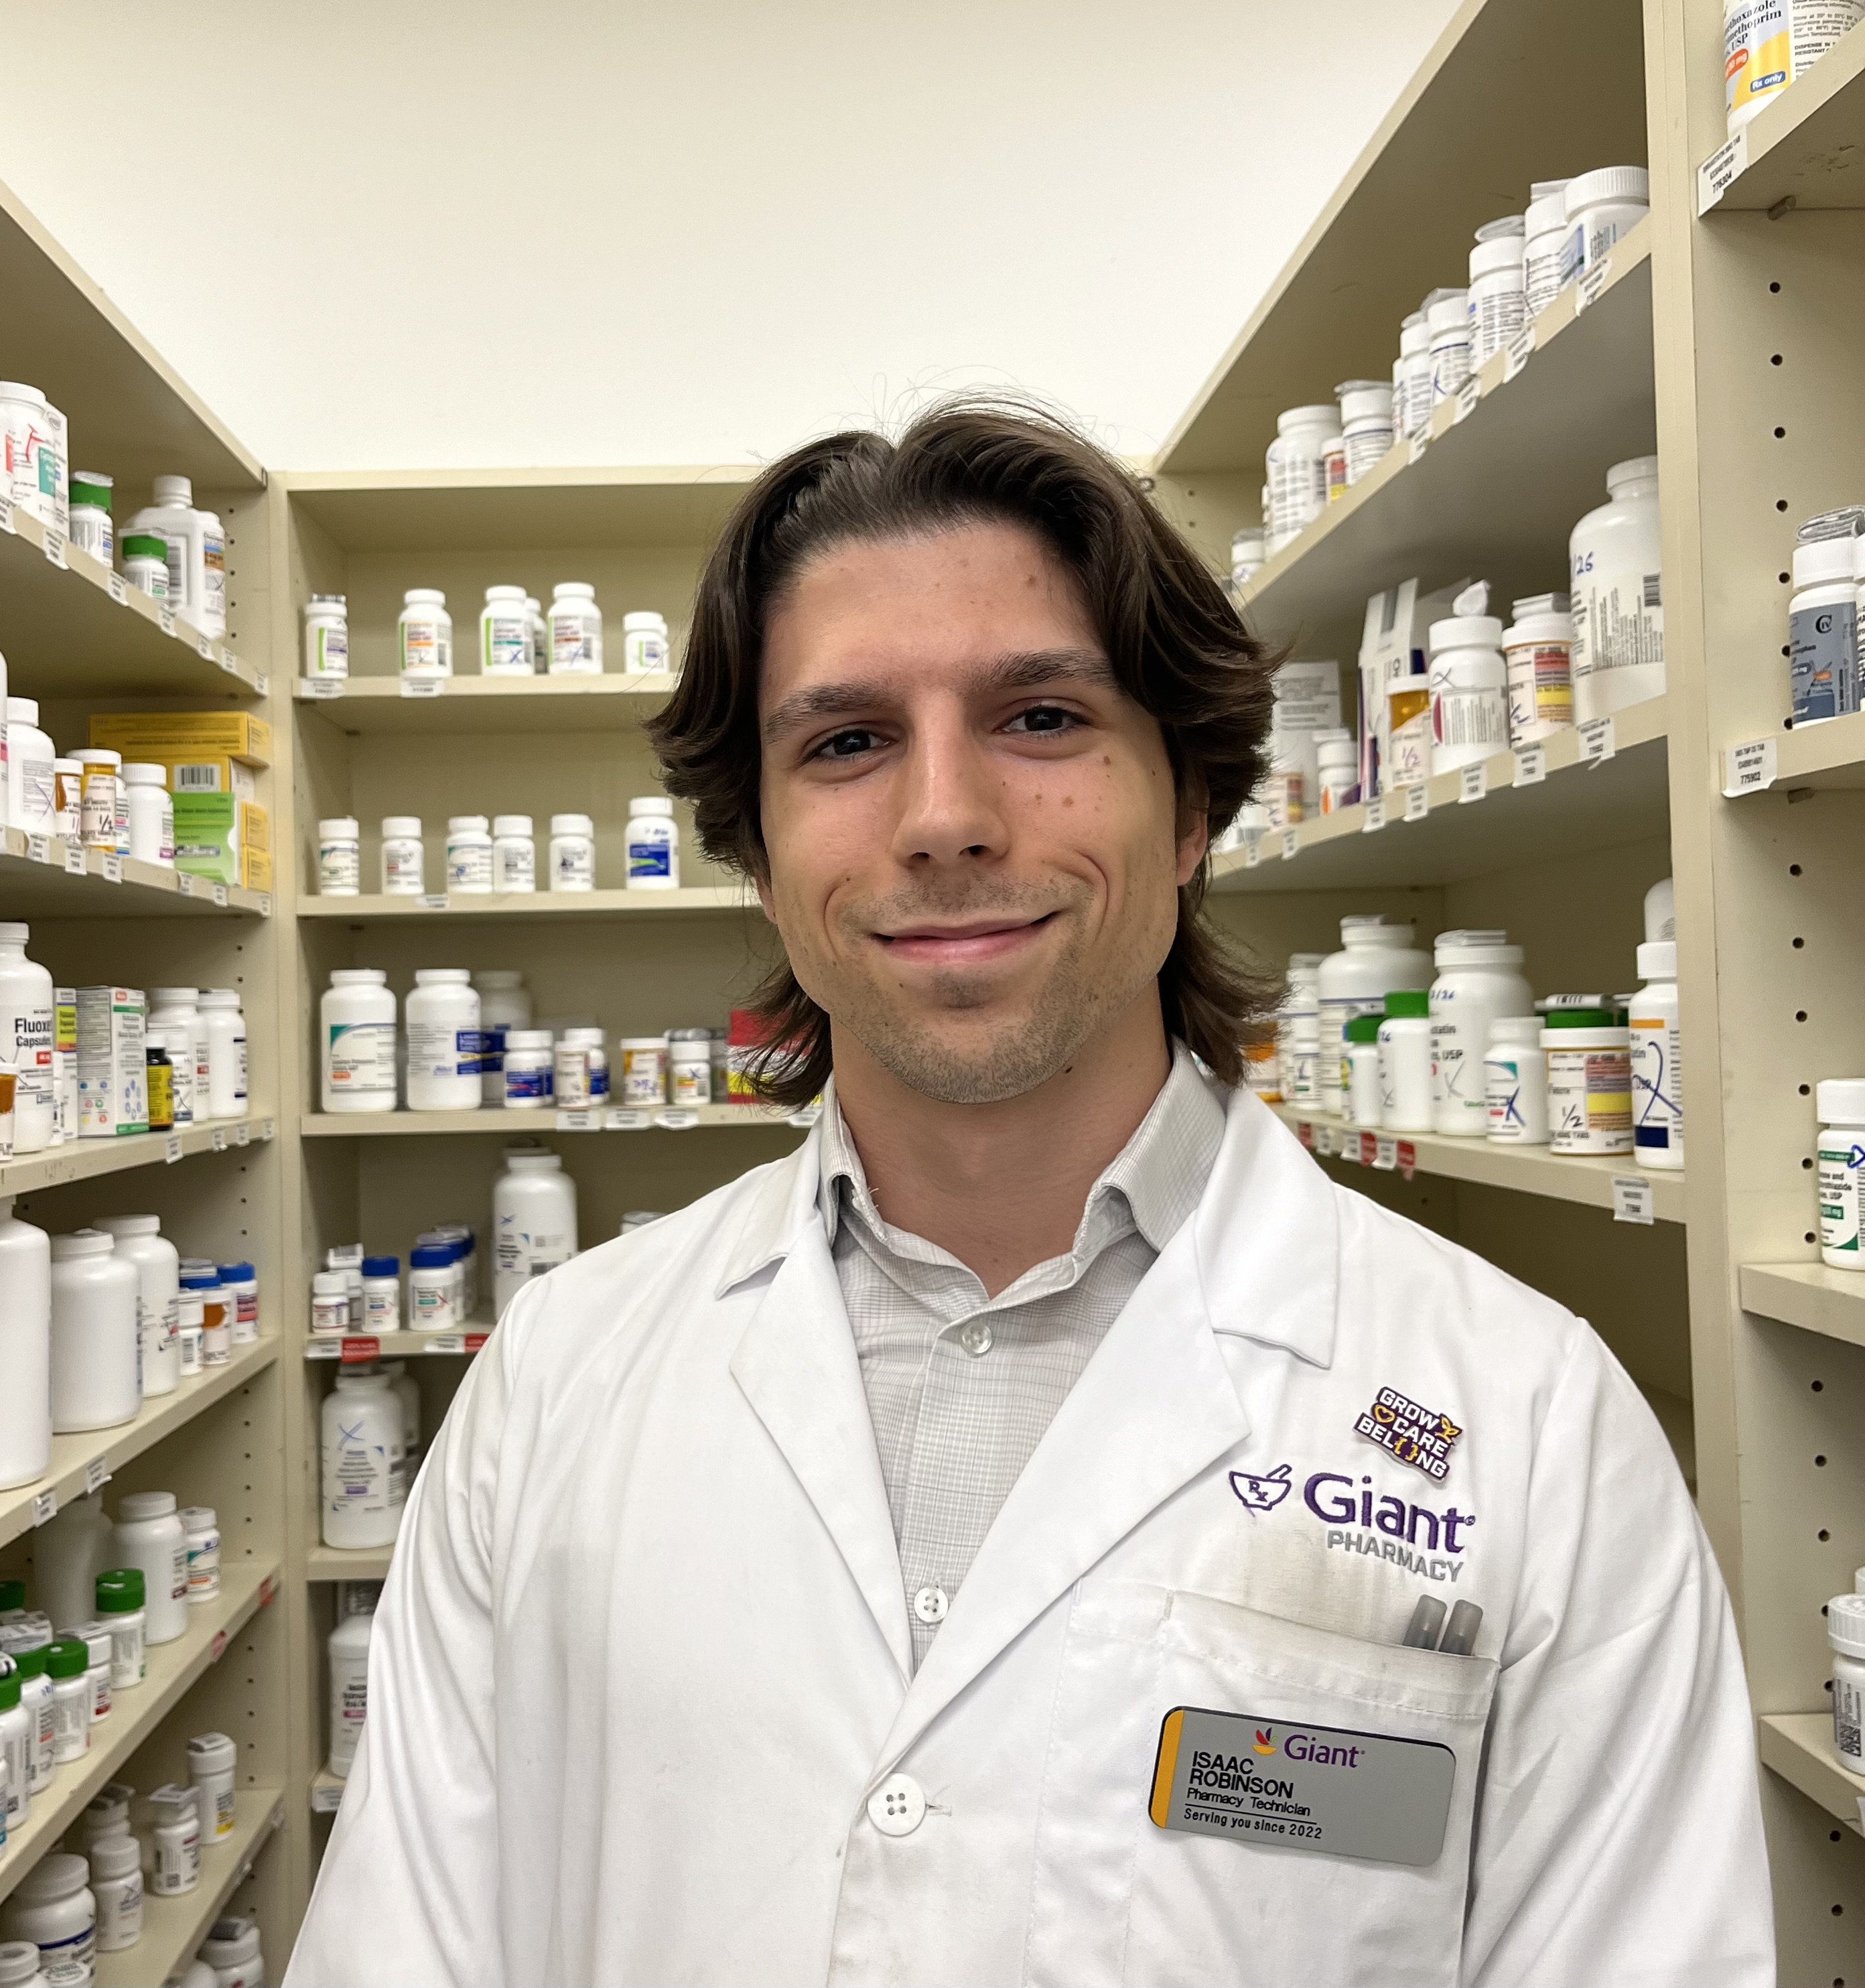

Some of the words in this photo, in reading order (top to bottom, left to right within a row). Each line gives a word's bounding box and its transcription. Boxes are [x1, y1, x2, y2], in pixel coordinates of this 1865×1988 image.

[1764, 72, 1783, 85] only
[1562, 1104, 1584, 1130] 1/2
[1379, 1389, 1440, 1431] GROW
[1392, 1416, 1448, 1458] CARE
[1327, 1530, 1464, 1583] PHARMACY
[1192, 1750, 1255, 1775] ISAAC
[1284, 1733, 1360, 1768] Giant
[1189, 1768, 1294, 1799] ROBINSON
[1186, 1787, 1244, 1808] Pharmacy
[1250, 1796, 1311, 1816] Technician
[1184, 1808, 1227, 1827] Serving
[1231, 1816, 1251, 1830] you
[1253, 1819, 1286, 1834] since
[1289, 1823, 1323, 1840] 2022
